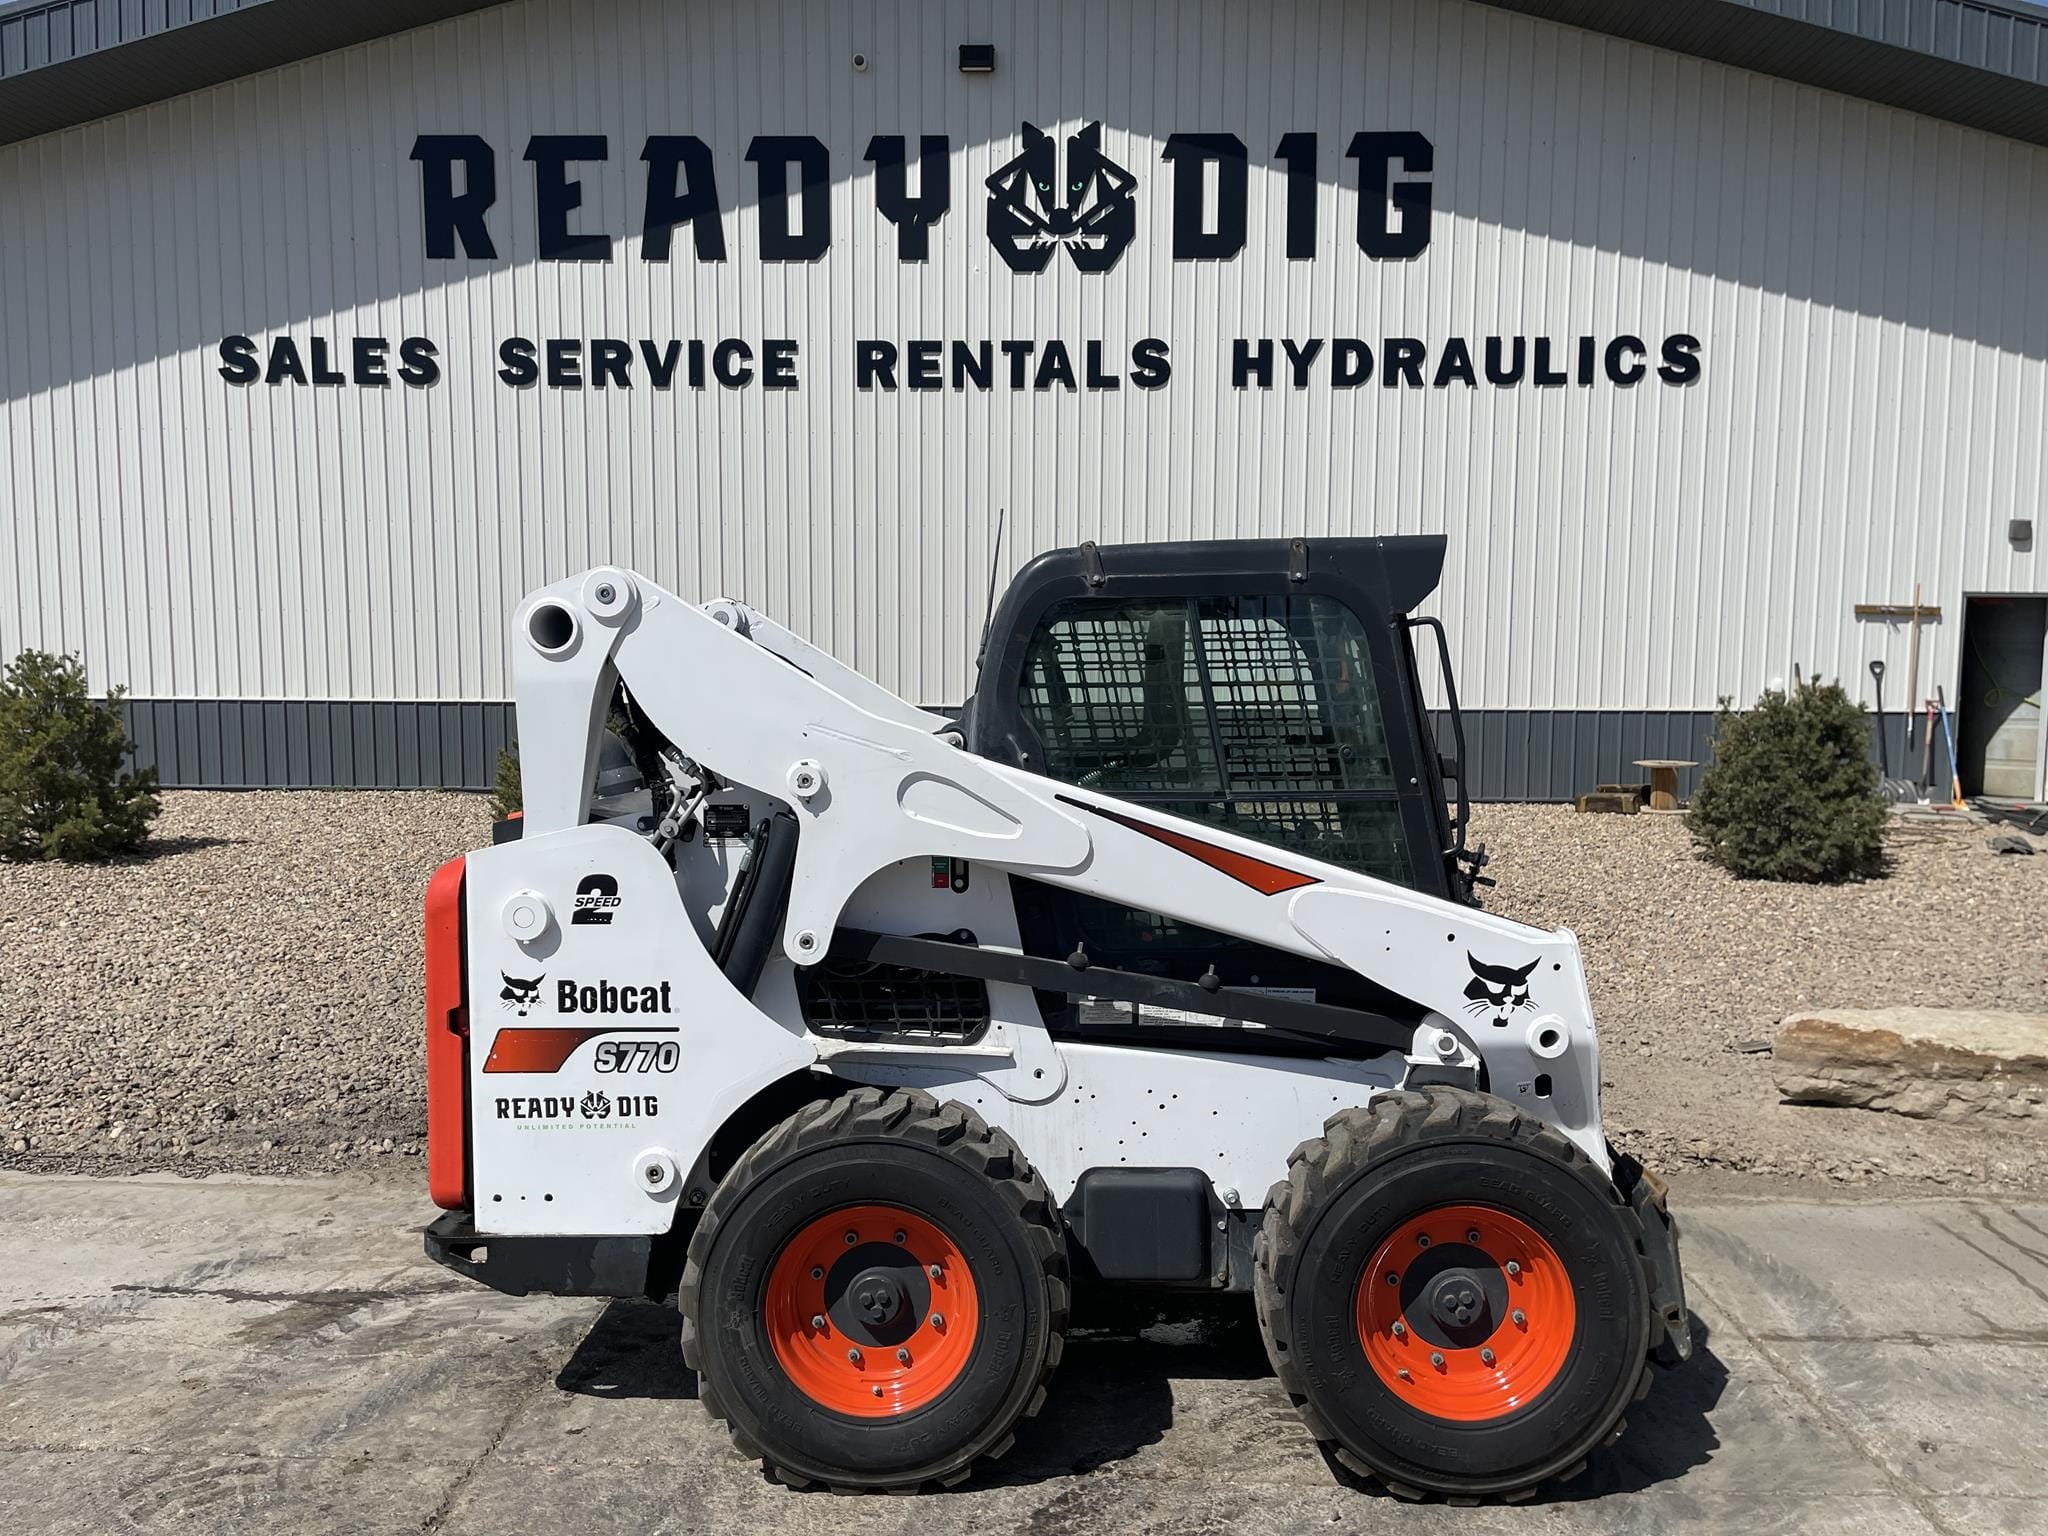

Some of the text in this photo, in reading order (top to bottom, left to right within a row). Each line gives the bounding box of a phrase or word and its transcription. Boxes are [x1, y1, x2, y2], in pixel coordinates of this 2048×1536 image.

[410, 131, 1433, 261] READY DIG
[219, 334, 1701, 389] SALES SERVICE RENTALS HYDRAULICS
[571, 874, 619, 925] 2
[574, 896, 622, 908] SPEED
[557, 979, 672, 1014] Bobcat
[594, 1041, 681, 1074] S770
[495, 1095, 659, 1119] READY DIG
[579, 1122, 637, 1130] POTENTIAL
